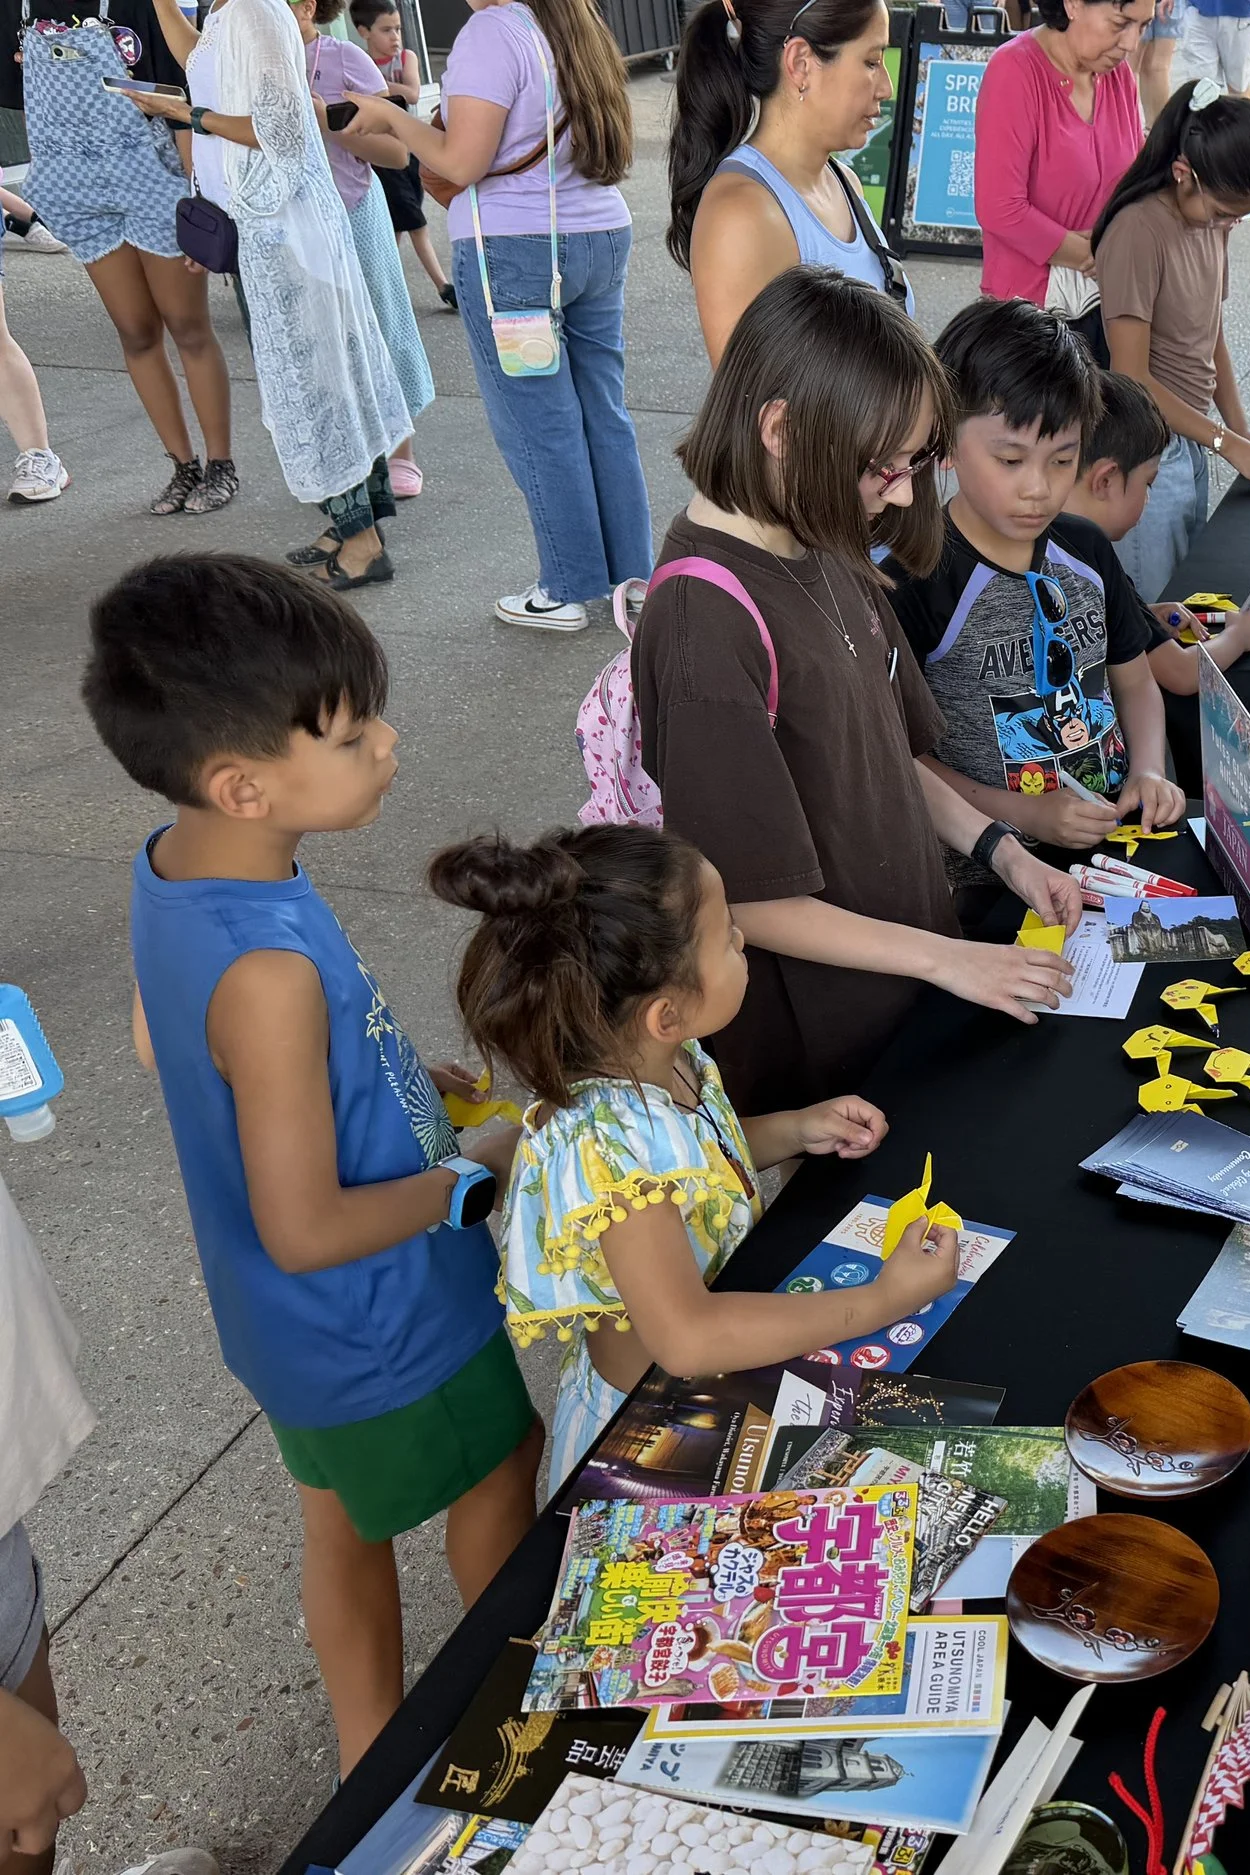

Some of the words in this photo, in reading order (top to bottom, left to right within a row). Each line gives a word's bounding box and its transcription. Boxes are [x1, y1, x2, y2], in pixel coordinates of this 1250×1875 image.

[944, 73, 980, 92] SPR
[979, 609, 1107, 681] AVEERS
[949, 1440, 977, 1478] 若竹
[940, 1490, 976, 1525] NEW
[585, 1560, 650, 1646] 楽しい街
[757, 1502, 890, 1681] 宇都宮
[932, 1630, 948, 1670] AREA
[977, 1629, 986, 1652] COOL
[945, 1630, 966, 1713] UTSUNOMIYA
[975, 1654, 984, 1678] JAPAN
[926, 1673, 944, 1714] GUIDE
